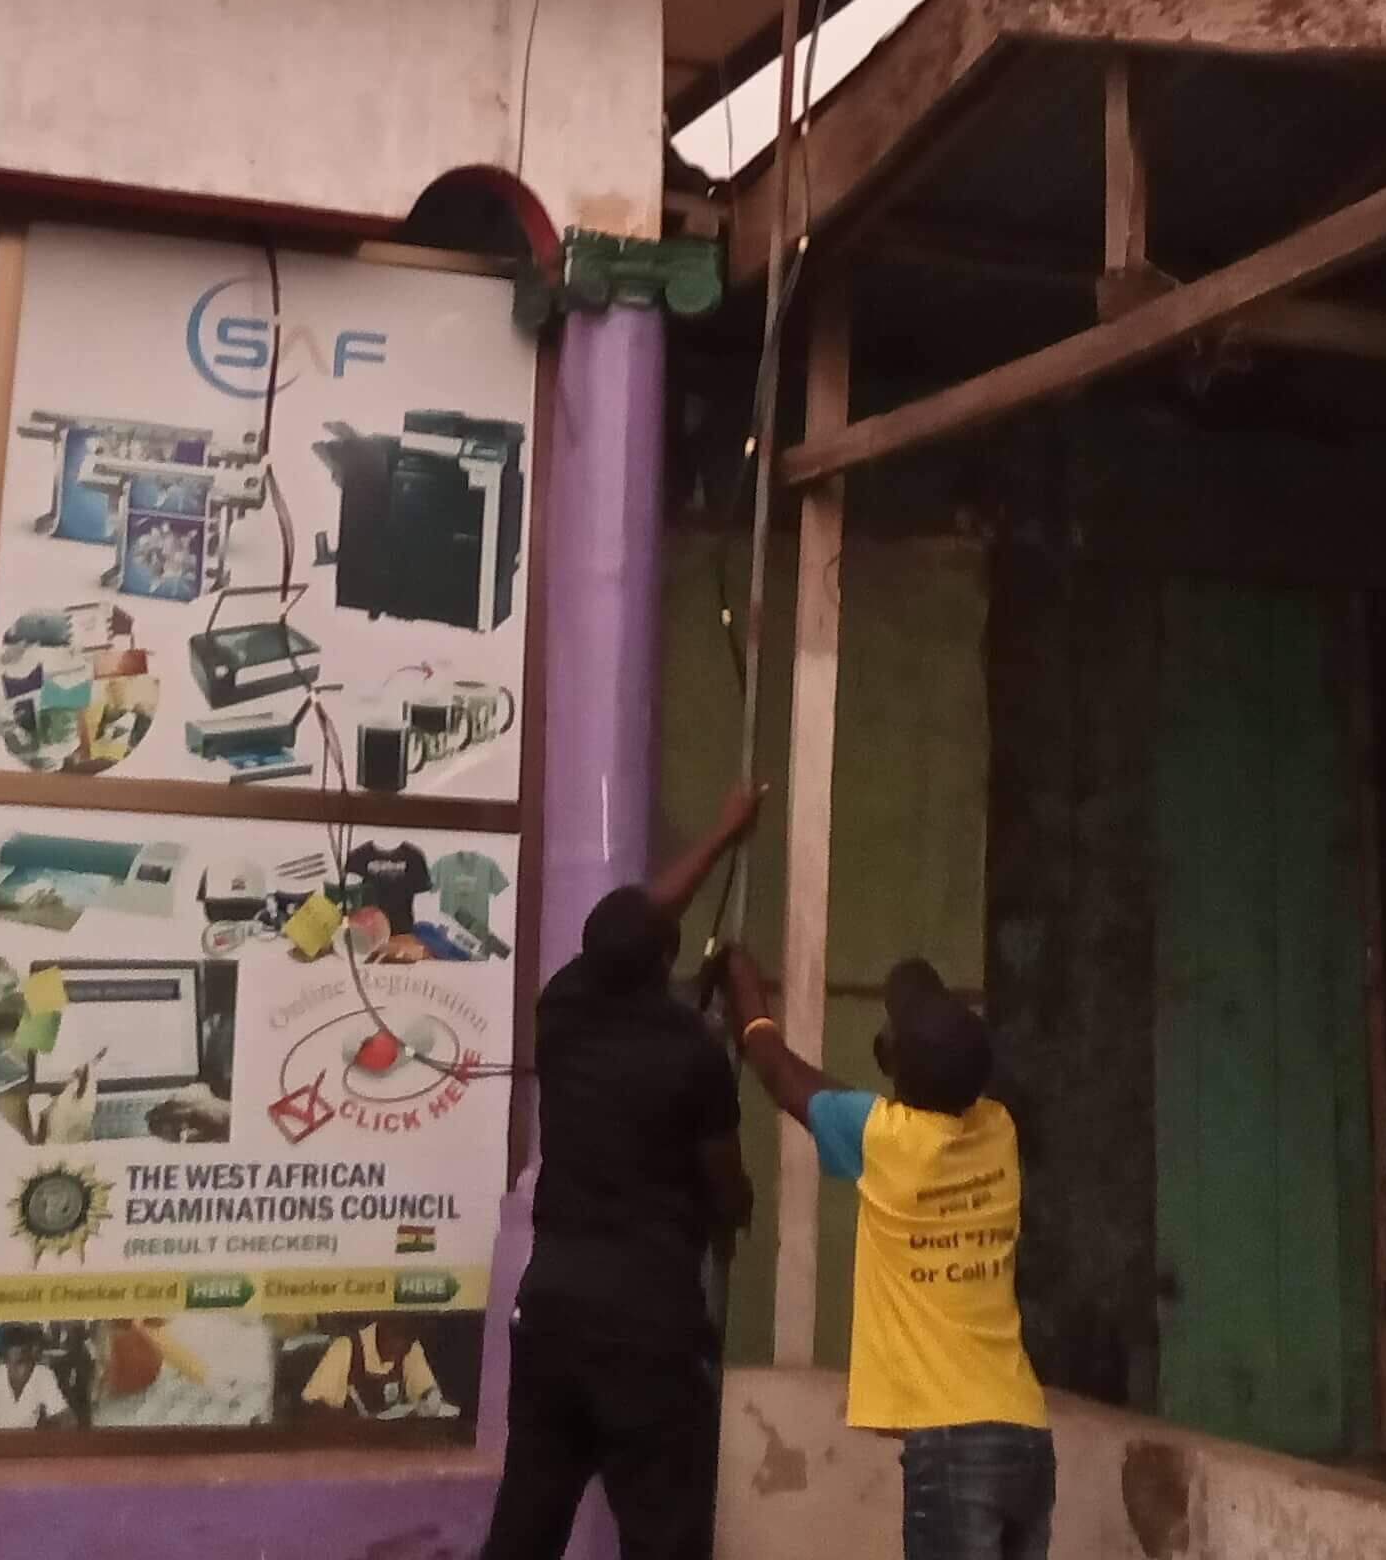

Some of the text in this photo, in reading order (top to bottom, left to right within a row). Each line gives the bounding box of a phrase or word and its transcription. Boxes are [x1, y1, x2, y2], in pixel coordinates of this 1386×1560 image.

[338, 1048, 482, 1134] CLICK HERE
[126, 1160, 387, 1192] THE WEST AFRICAN
[125, 1193, 461, 1225] EXAMINATIONS COUNCIL
[226, 1233, 339, 1256] CHECKER)
